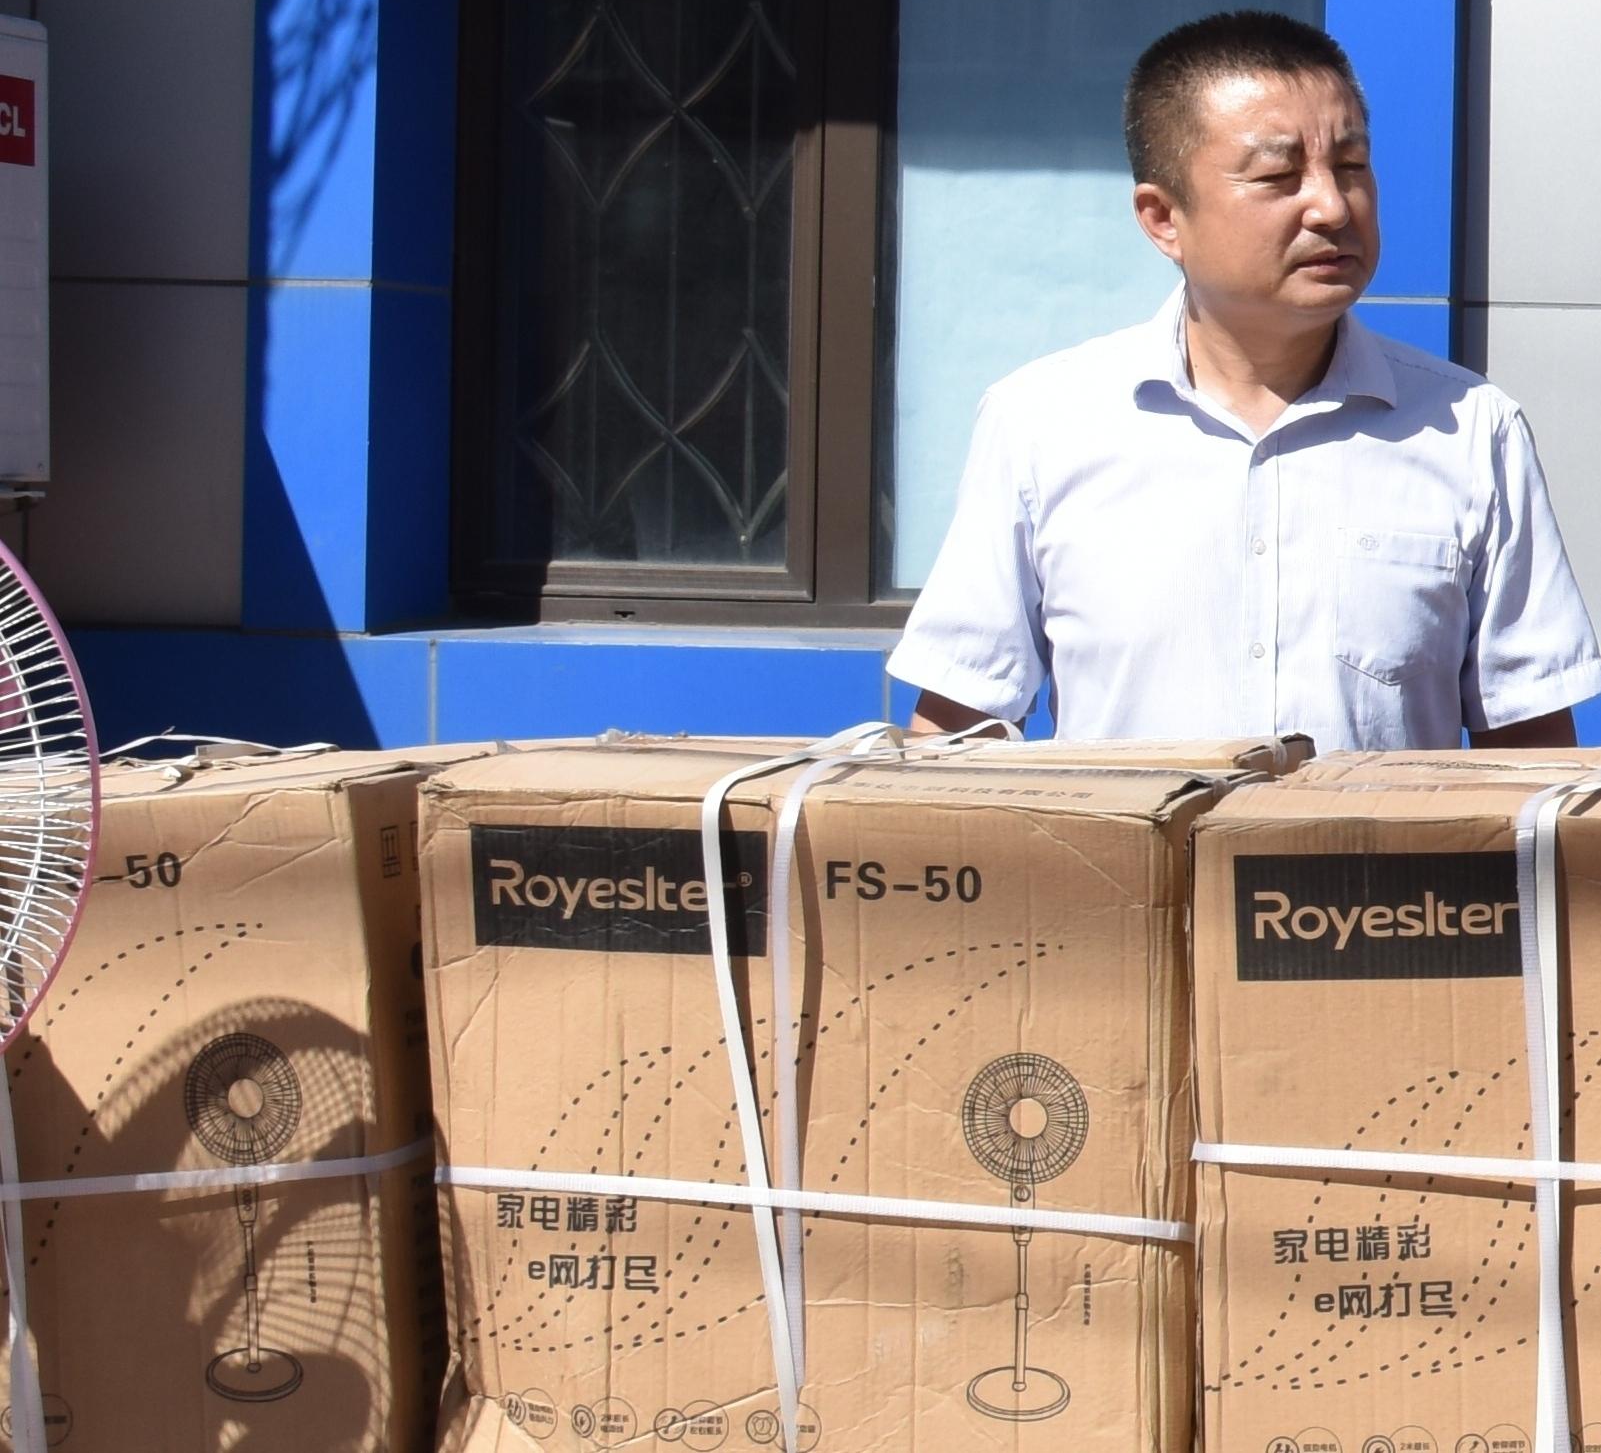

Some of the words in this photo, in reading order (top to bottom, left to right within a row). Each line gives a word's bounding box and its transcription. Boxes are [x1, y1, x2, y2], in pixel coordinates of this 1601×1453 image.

[824, 860, 983, 904] FS-50
[497, 1193, 637, 1234] 家电精彩
[1273, 1223, 1431, 1264] 家电精彩
[528, 1253, 660, 1294] e网打尽
[1314, 1280, 1457, 1320] e网打尽
